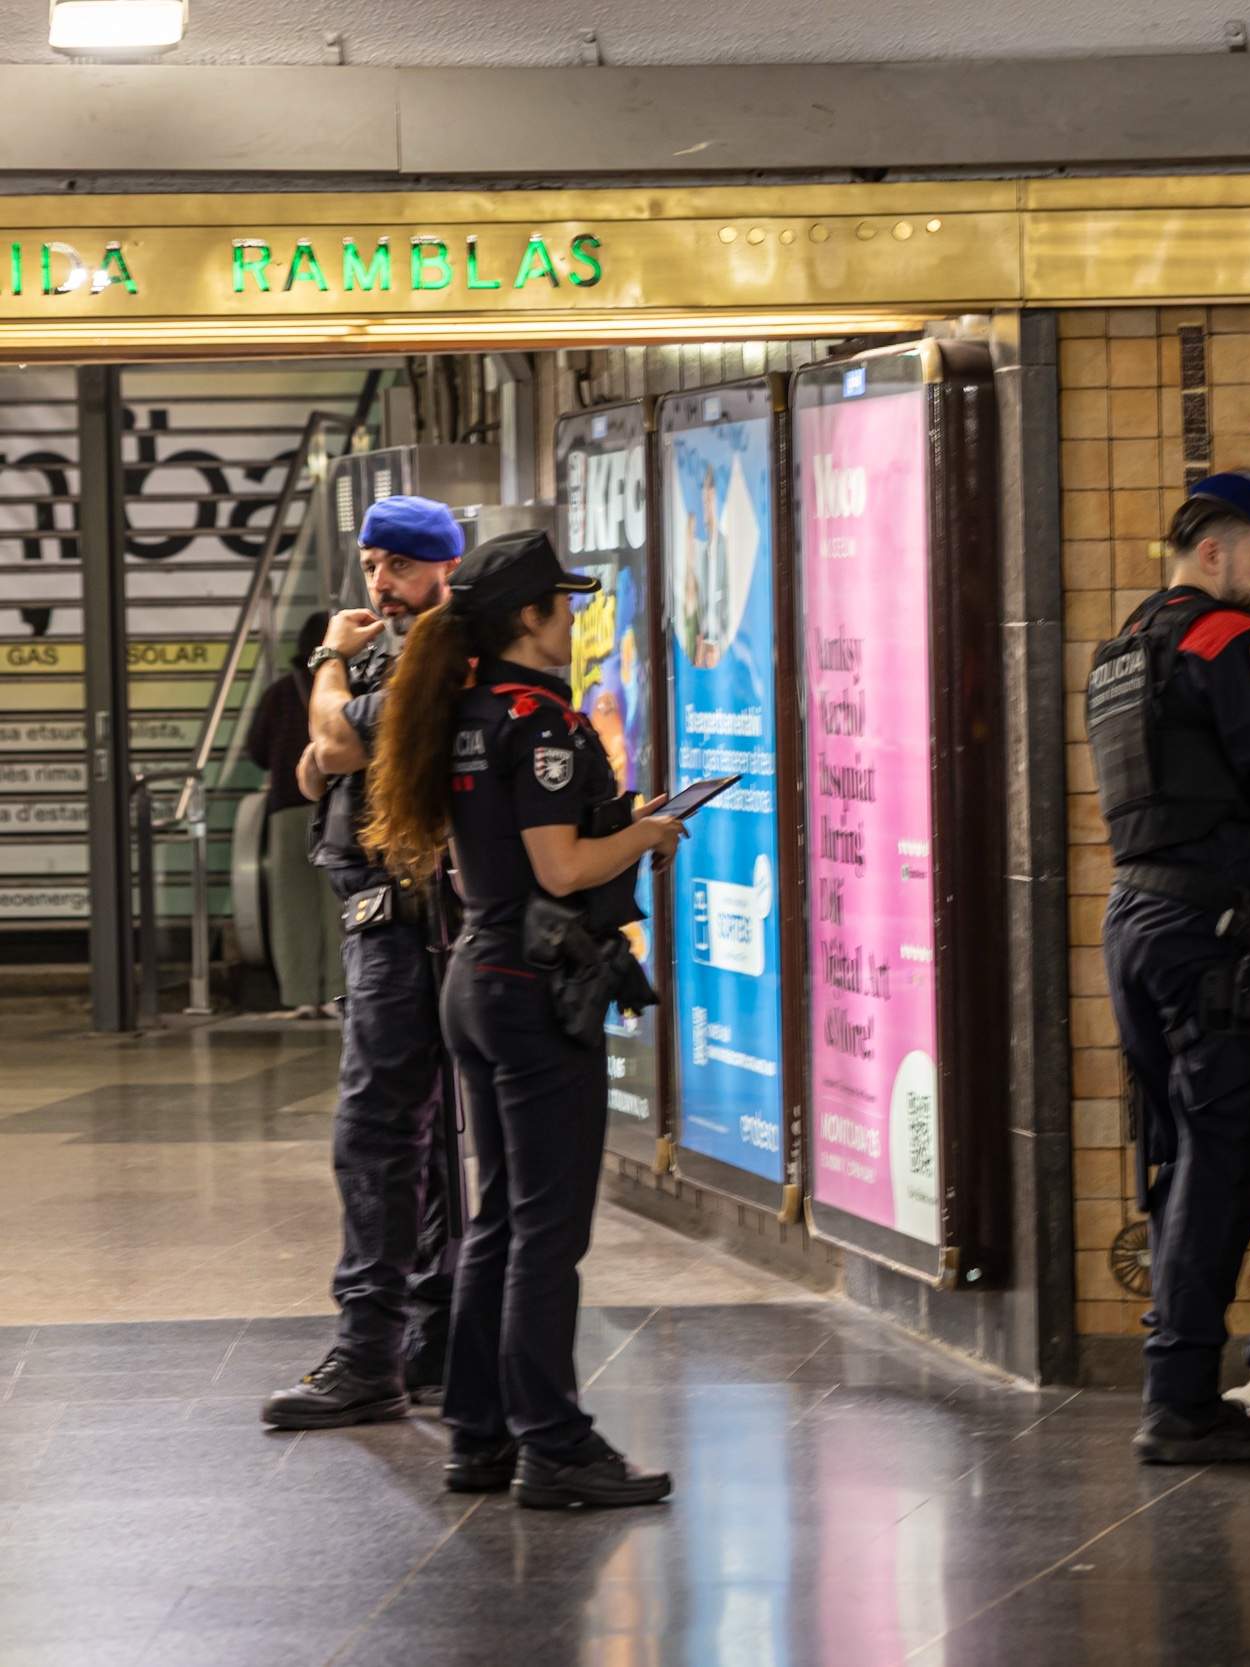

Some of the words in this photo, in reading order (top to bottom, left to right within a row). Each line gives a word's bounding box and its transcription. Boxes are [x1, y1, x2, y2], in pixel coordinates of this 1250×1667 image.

[231, 233, 604, 294] RAMBLAS
[7, 646, 59, 666] GAS
[127, 645, 209, 666] SOLAR
